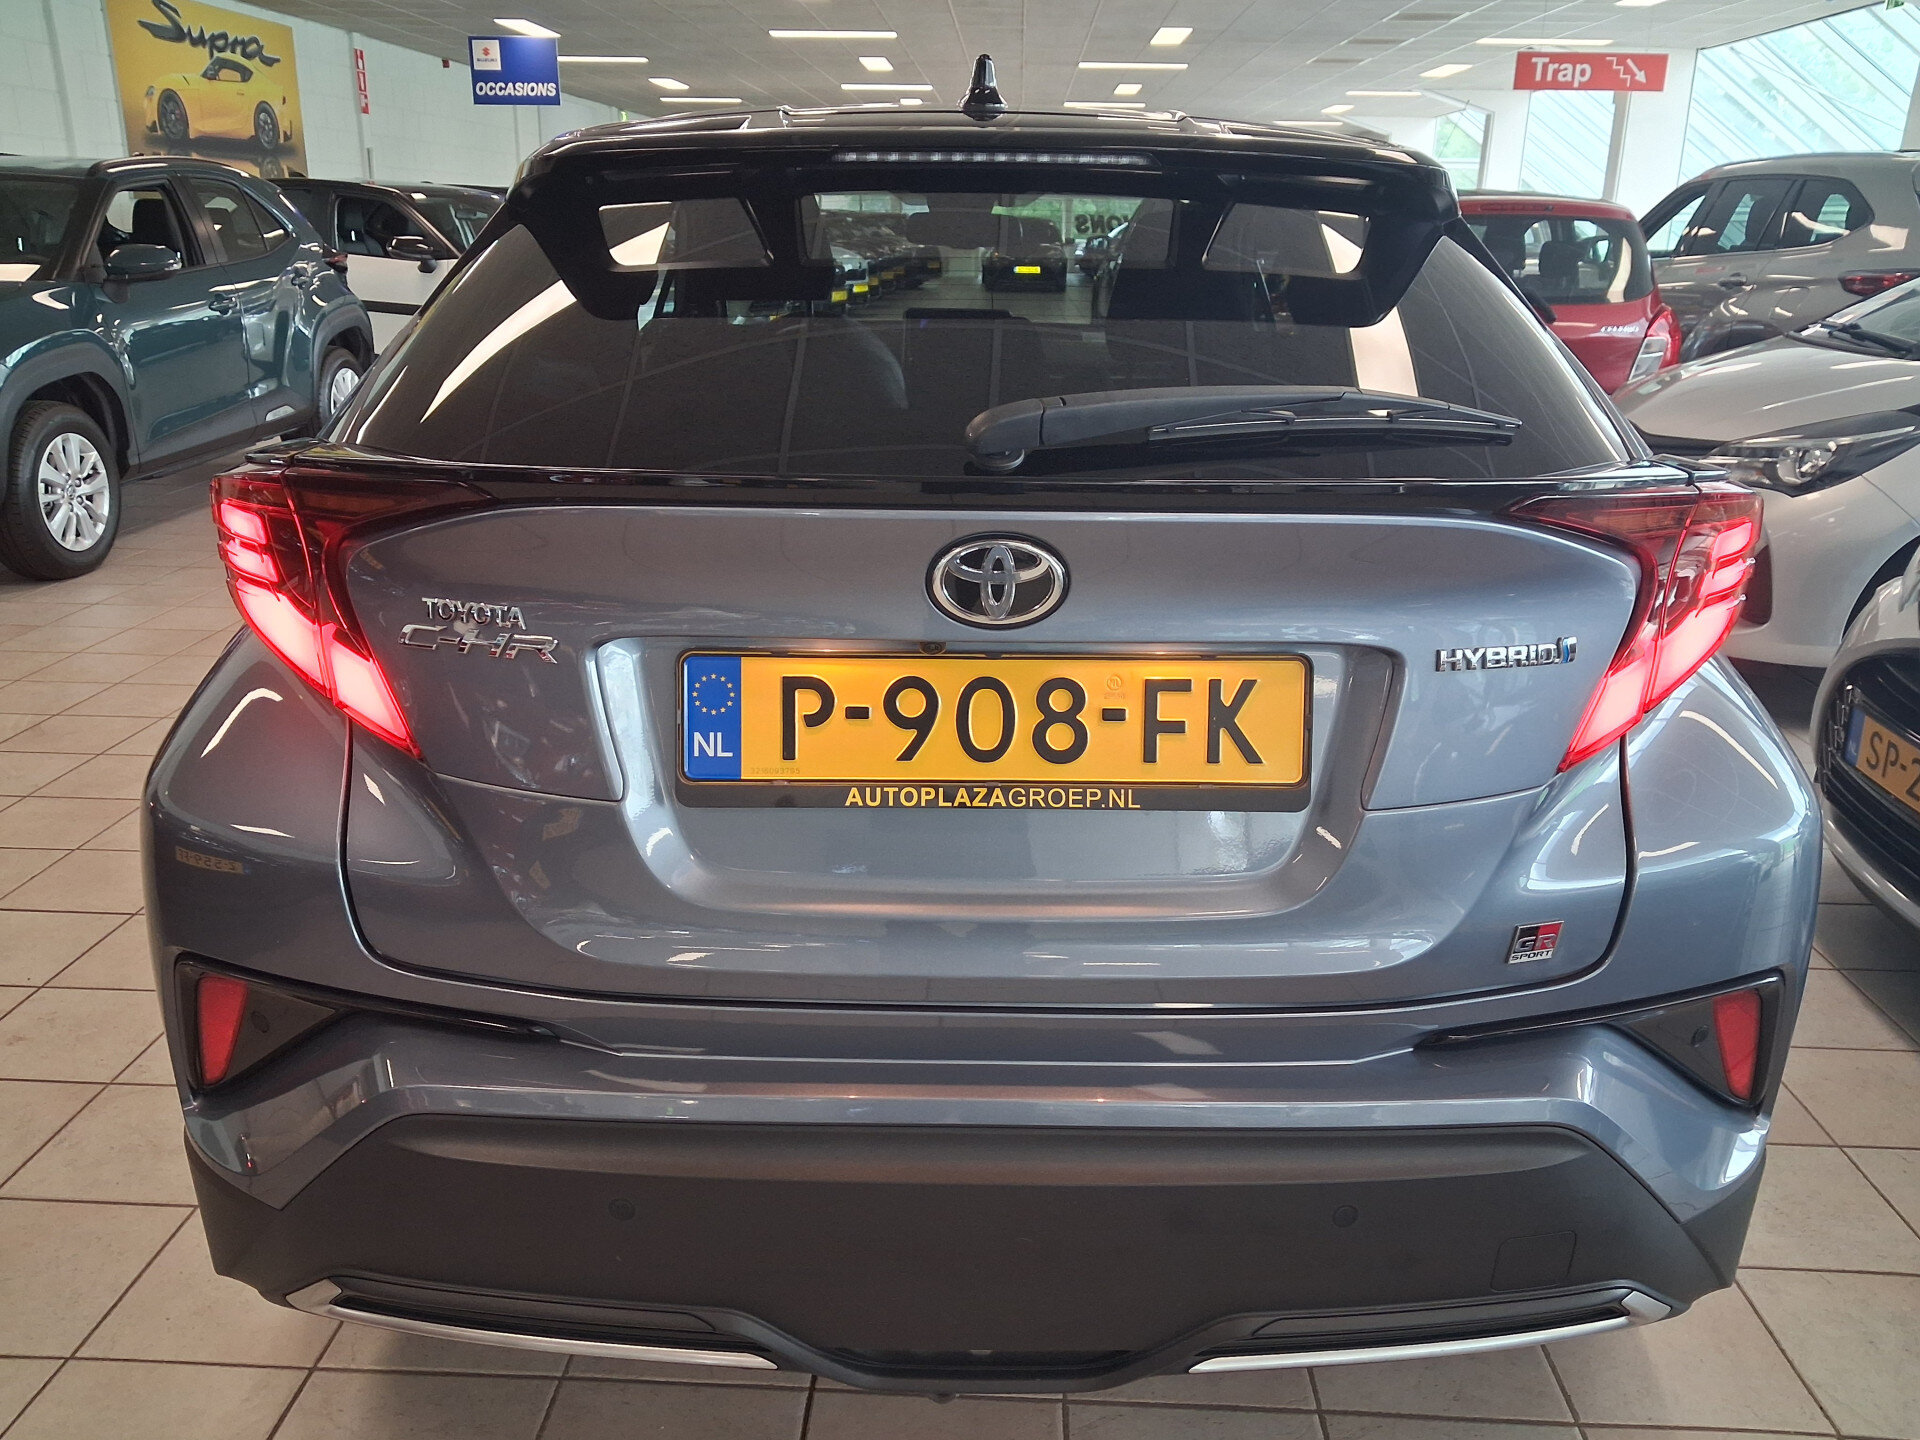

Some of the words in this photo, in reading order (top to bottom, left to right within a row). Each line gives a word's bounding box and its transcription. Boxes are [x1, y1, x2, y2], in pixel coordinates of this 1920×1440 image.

[137, 0, 281, 67] Supra
[1531, 57, 1592, 88] Trap
[475, 82, 557, 97] OCCASIONS
[421, 597, 527, 631] TOYOTA
[398, 624, 558, 664] C-HR
[1435, 643, 1559, 672] HYBRID
[781, 675, 1264, 764] P-908-FK
[693, 731, 733, 757] NL
[845, 787, 1141, 808] AUTOPLAZAGROEP.NL
[1511, 950, 1550, 961] SPORT
[1515, 933, 1557, 952] GR
